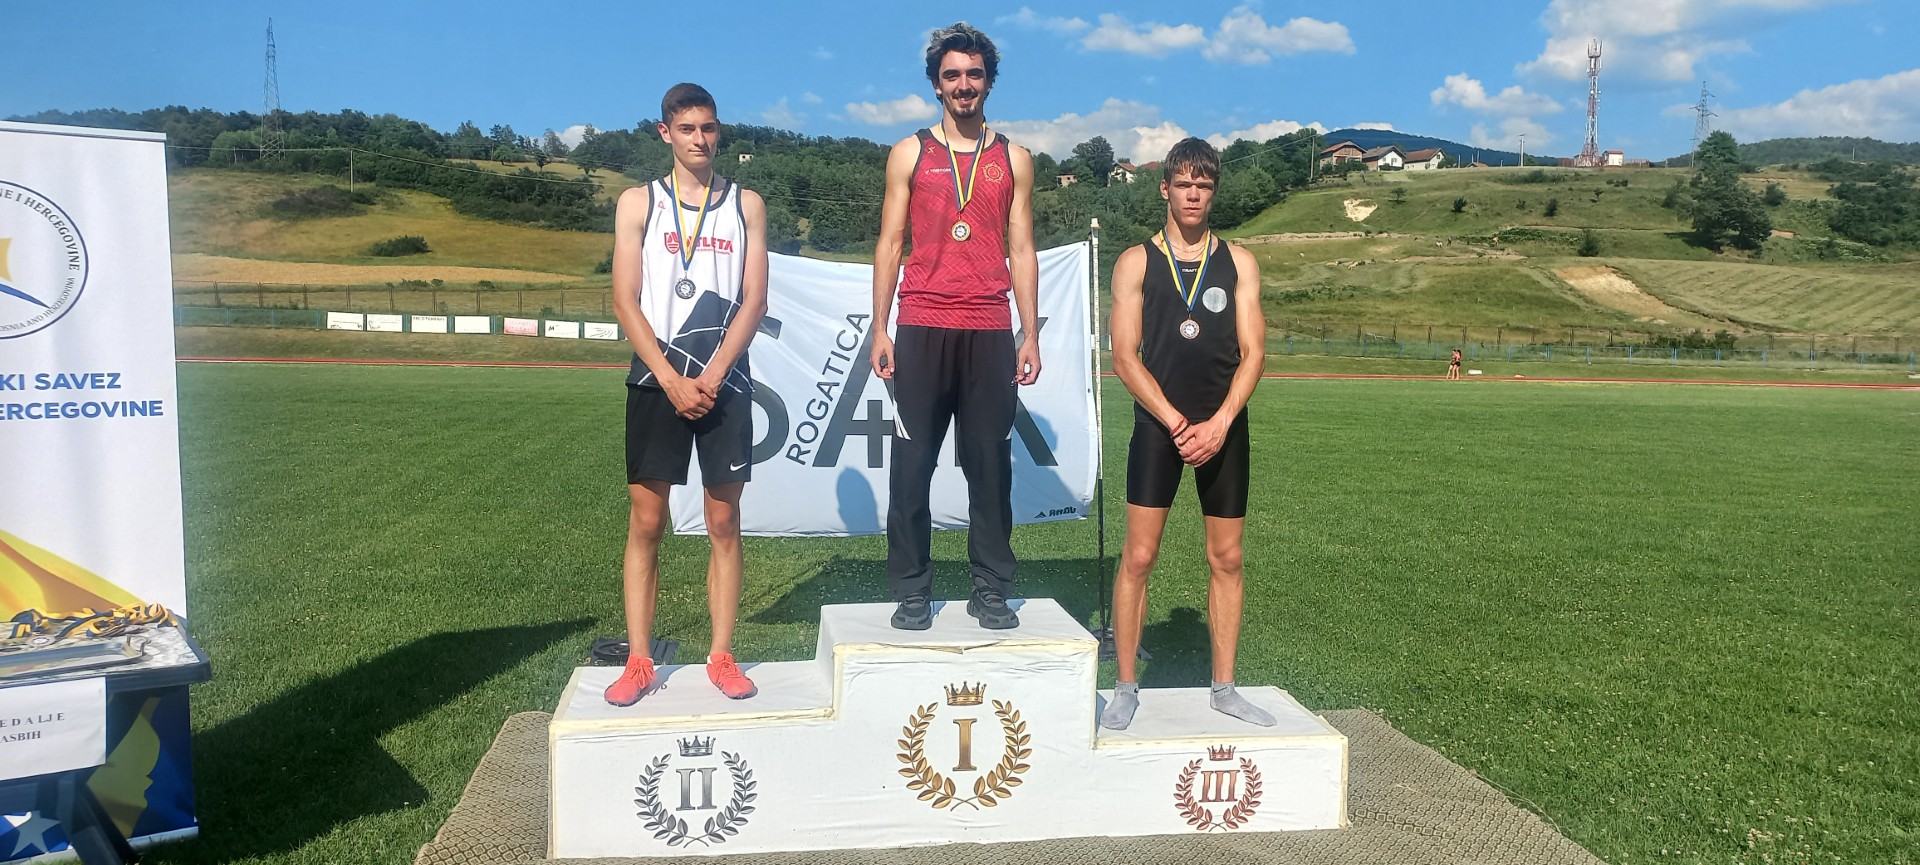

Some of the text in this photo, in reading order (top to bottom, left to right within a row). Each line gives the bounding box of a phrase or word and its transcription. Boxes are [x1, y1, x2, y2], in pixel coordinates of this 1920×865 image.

[15, 193, 23, 202] I
[23, 197, 80, 271] HERCEGOVINE
[27, 314, 44, 326] AND
[34, 372, 122, 391] SAVEZ
[786, 314, 870, 465] ROGATICA
[952, 718, 978, 772] I
[675, 767, 718, 811] II
[1198, 770, 1241, 803] III
